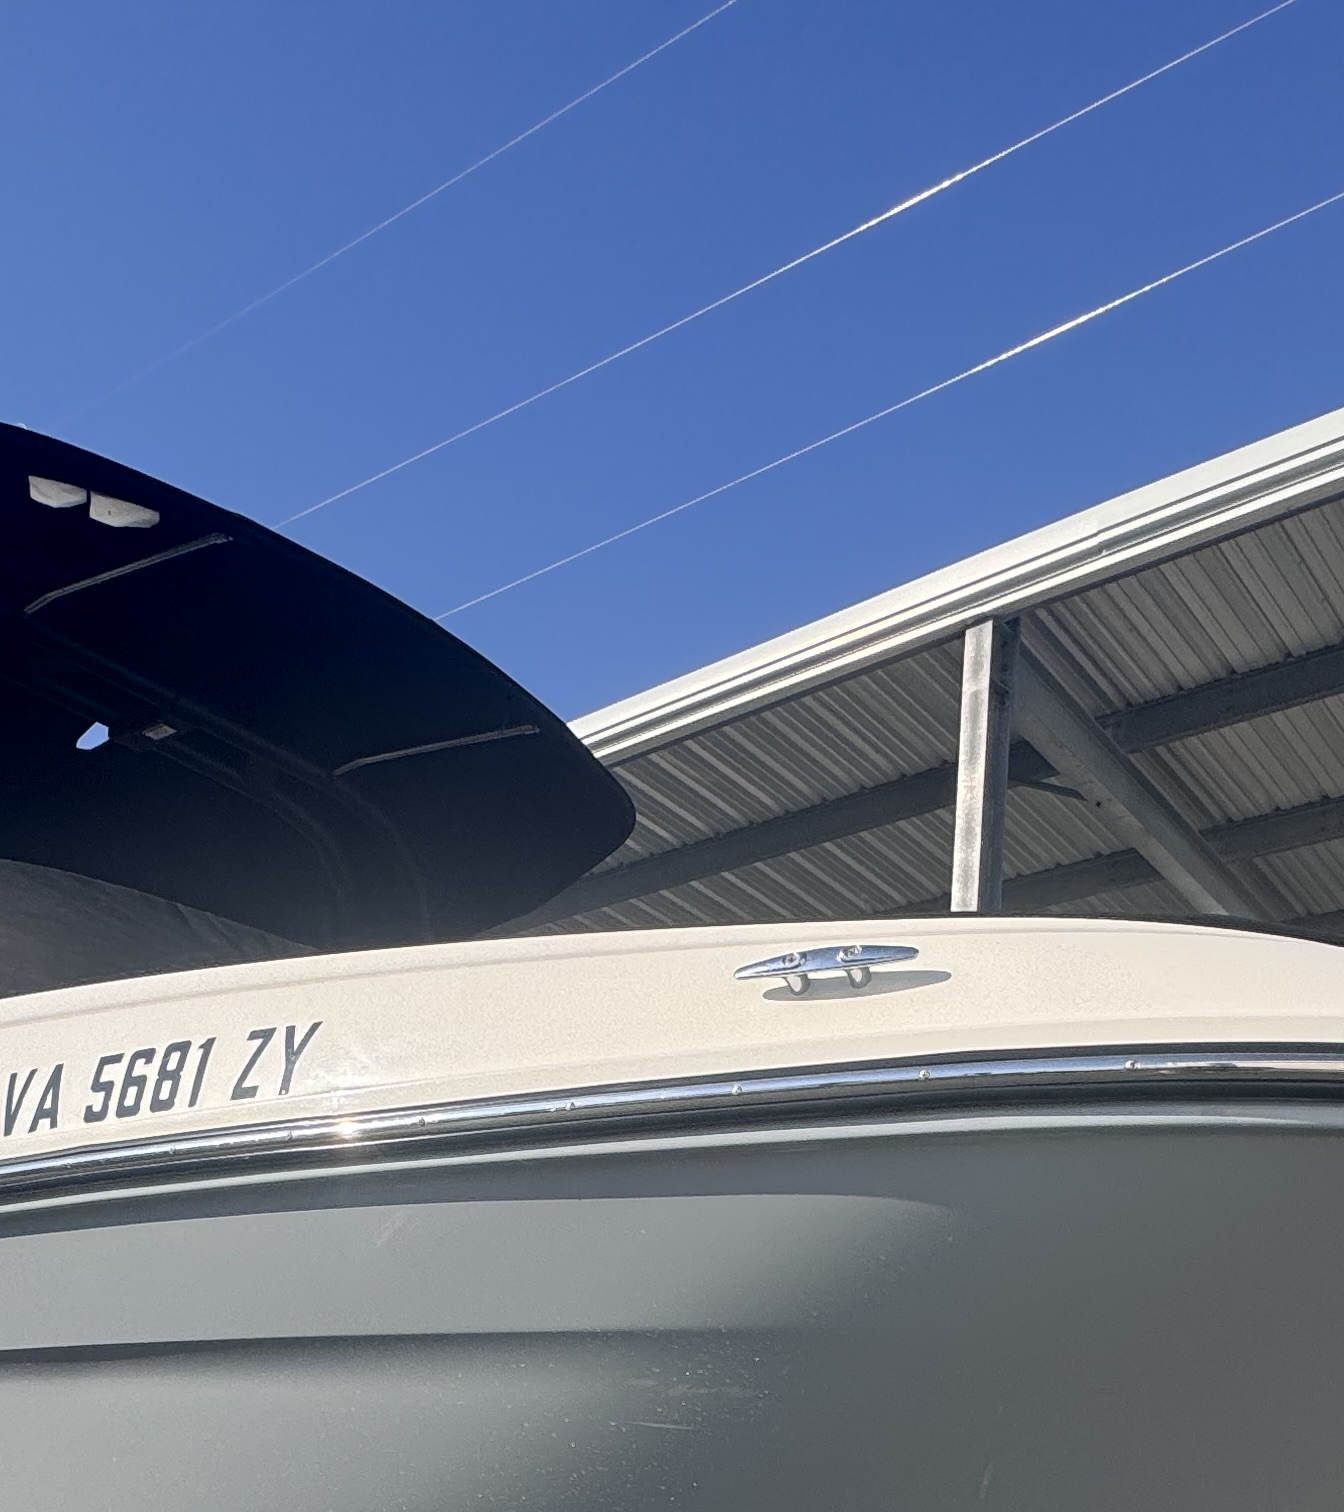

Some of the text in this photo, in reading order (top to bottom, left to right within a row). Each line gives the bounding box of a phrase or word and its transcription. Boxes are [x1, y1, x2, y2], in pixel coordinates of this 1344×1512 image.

[3, 1020, 324, 1137] VA 5681 ZY
